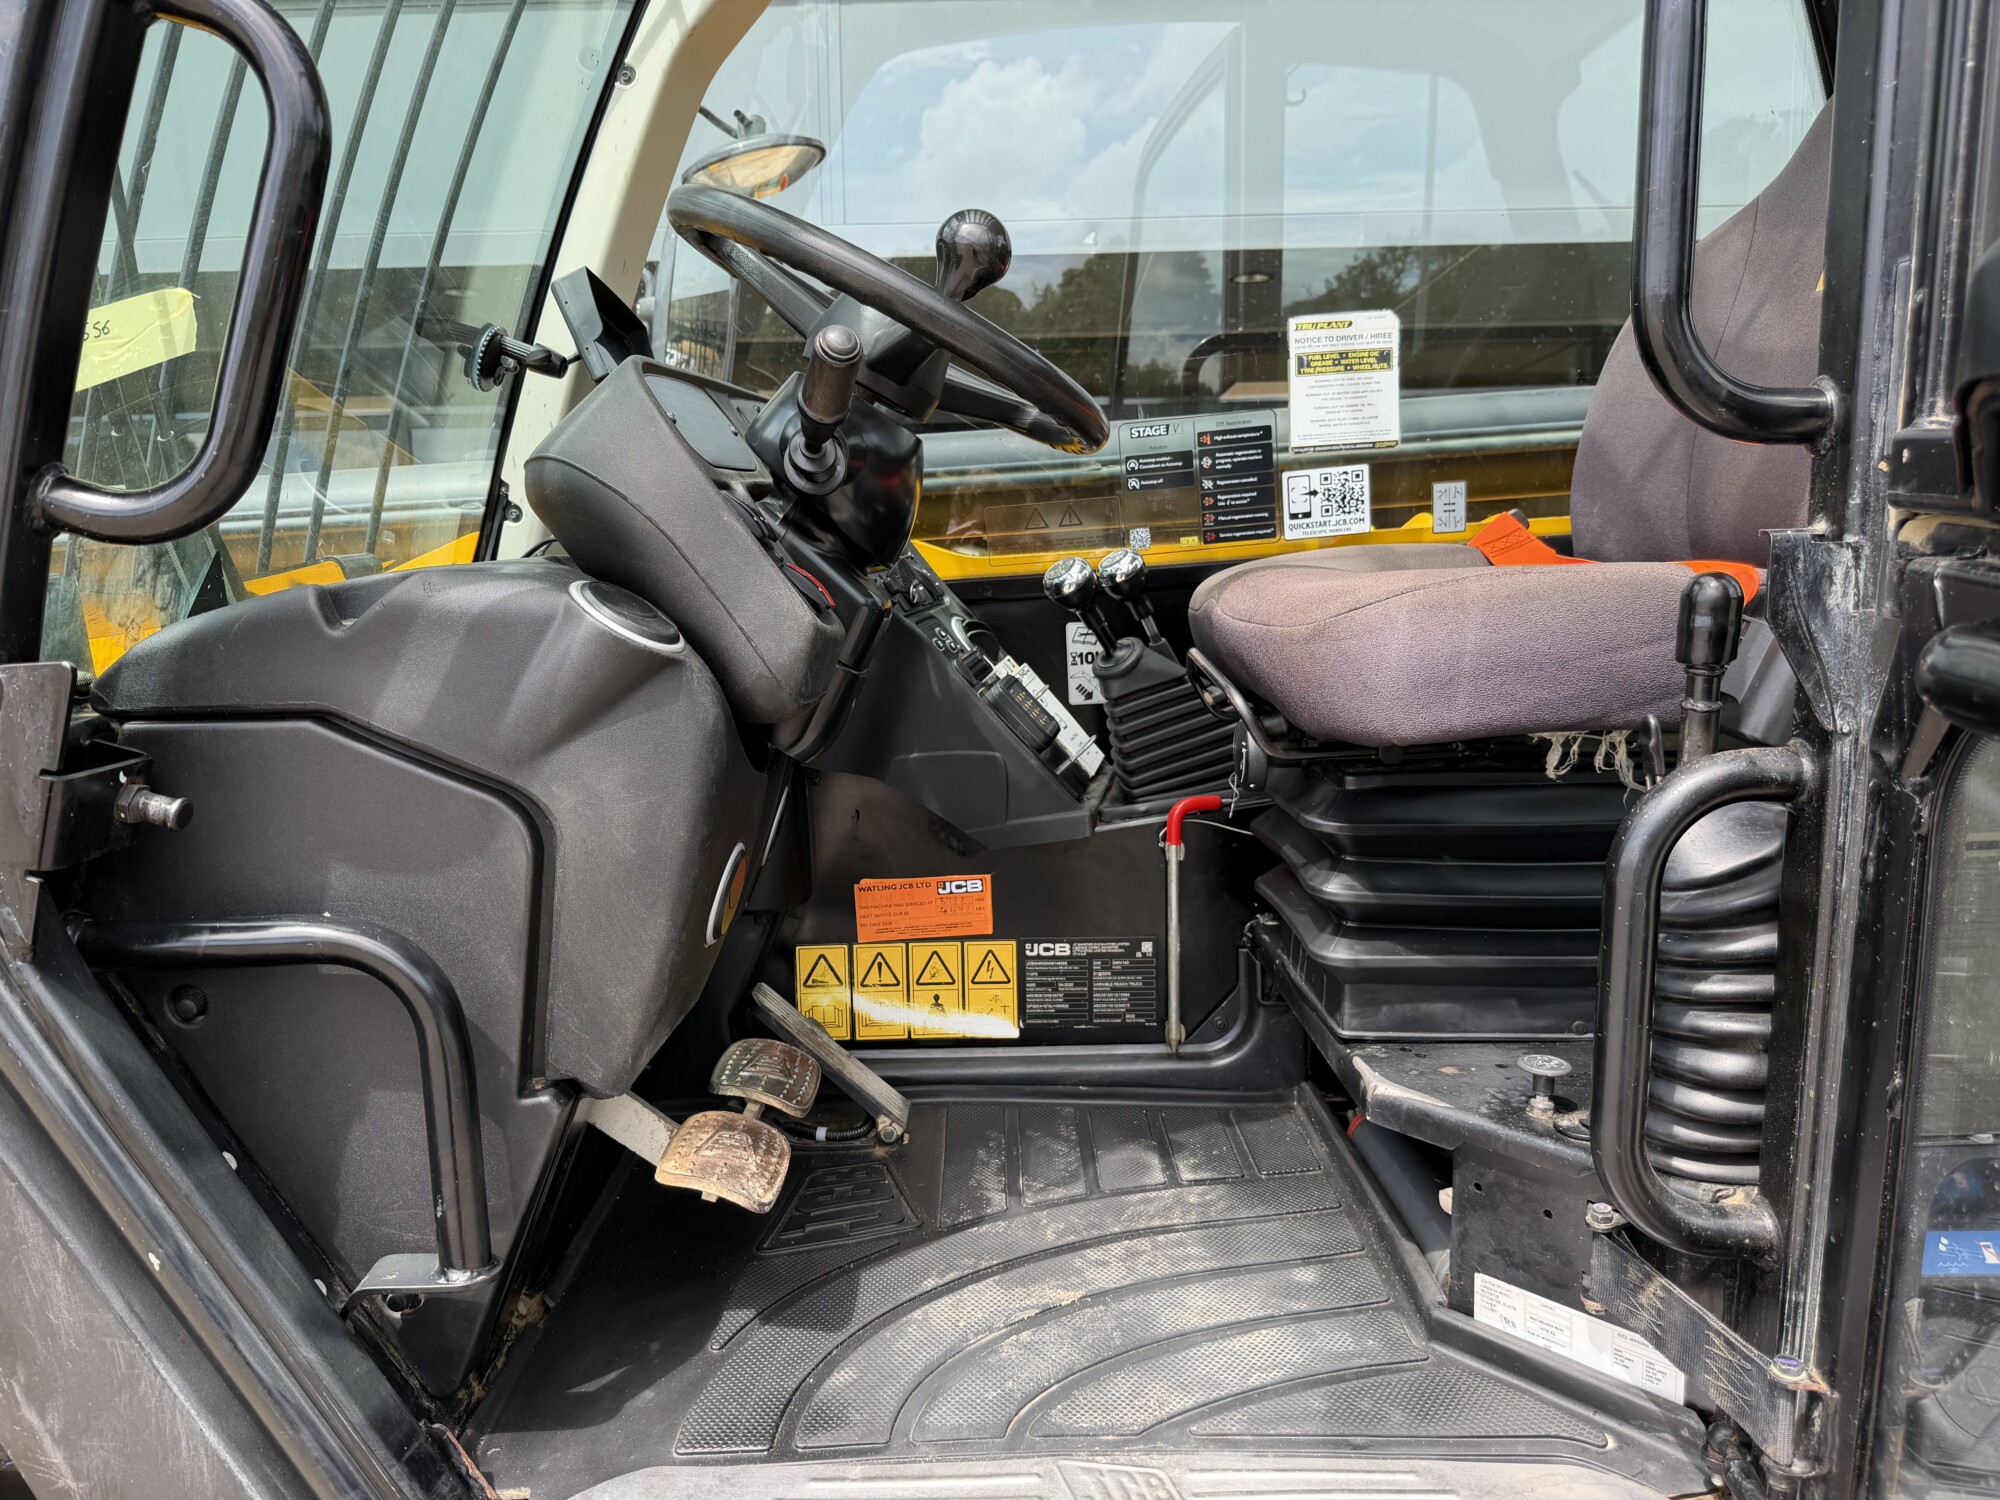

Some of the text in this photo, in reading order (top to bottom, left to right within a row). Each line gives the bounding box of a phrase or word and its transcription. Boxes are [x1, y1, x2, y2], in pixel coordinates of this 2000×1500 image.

[1294, 336, 1322, 344] NOTICE
[1131, 424, 1179, 437] STAGE V
[1288, 517, 1365, 531] QUICKSTART.JCB.COM
[858, 884, 897, 893] WATLING
[937, 880, 983, 894] JCB
[1025, 943, 1071, 956] JCB
